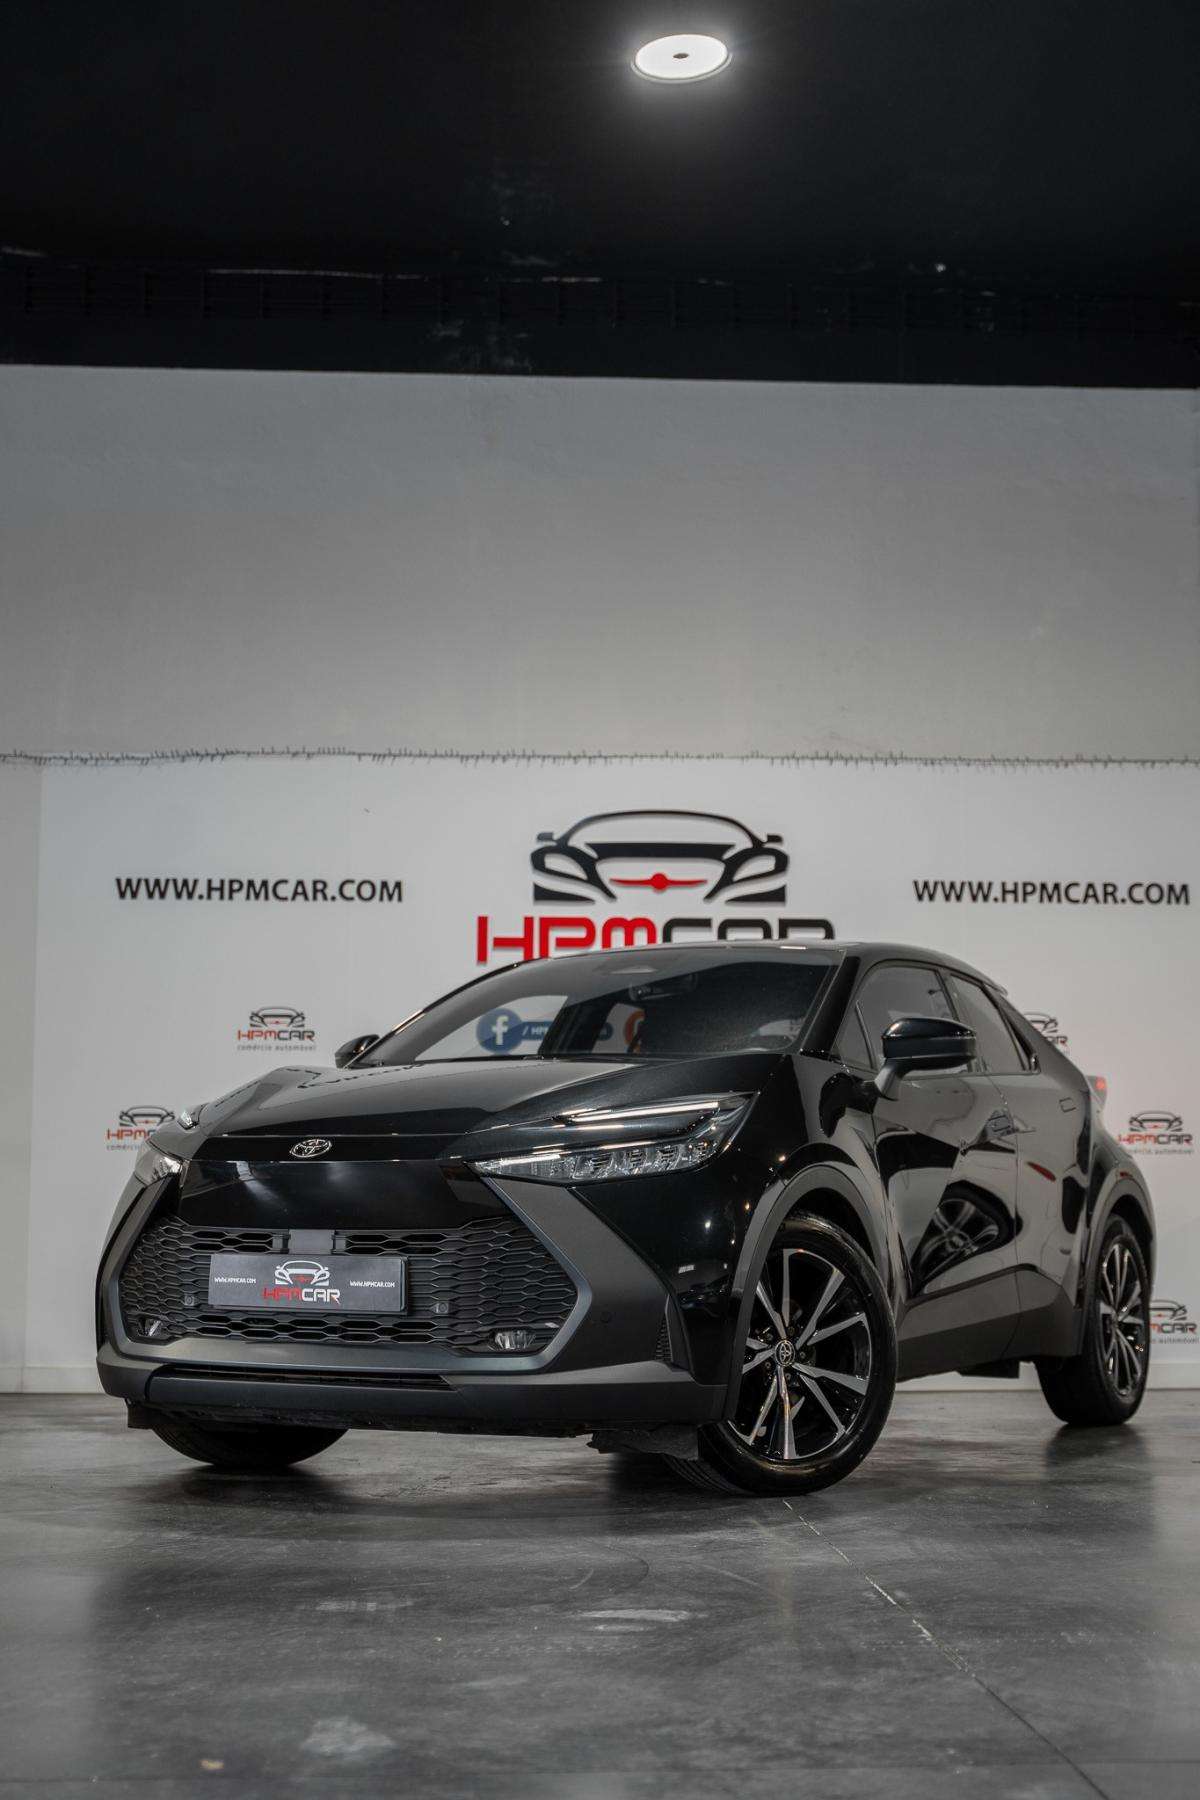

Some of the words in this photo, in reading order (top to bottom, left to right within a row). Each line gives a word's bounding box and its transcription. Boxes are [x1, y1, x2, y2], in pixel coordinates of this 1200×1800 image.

[115, 877, 403, 902] WWW.HPMCAR.COM
[913, 880, 1190, 905] WWW.HPMCAR.COM
[238, 1030, 315, 1041] HPMCAR
[214, 1276, 257, 1285] WWW.HPMCAR.COM
[350, 1280, 396, 1289] WWW.HPMCAR.COM
[263, 1287, 341, 1305] HPMCAR
